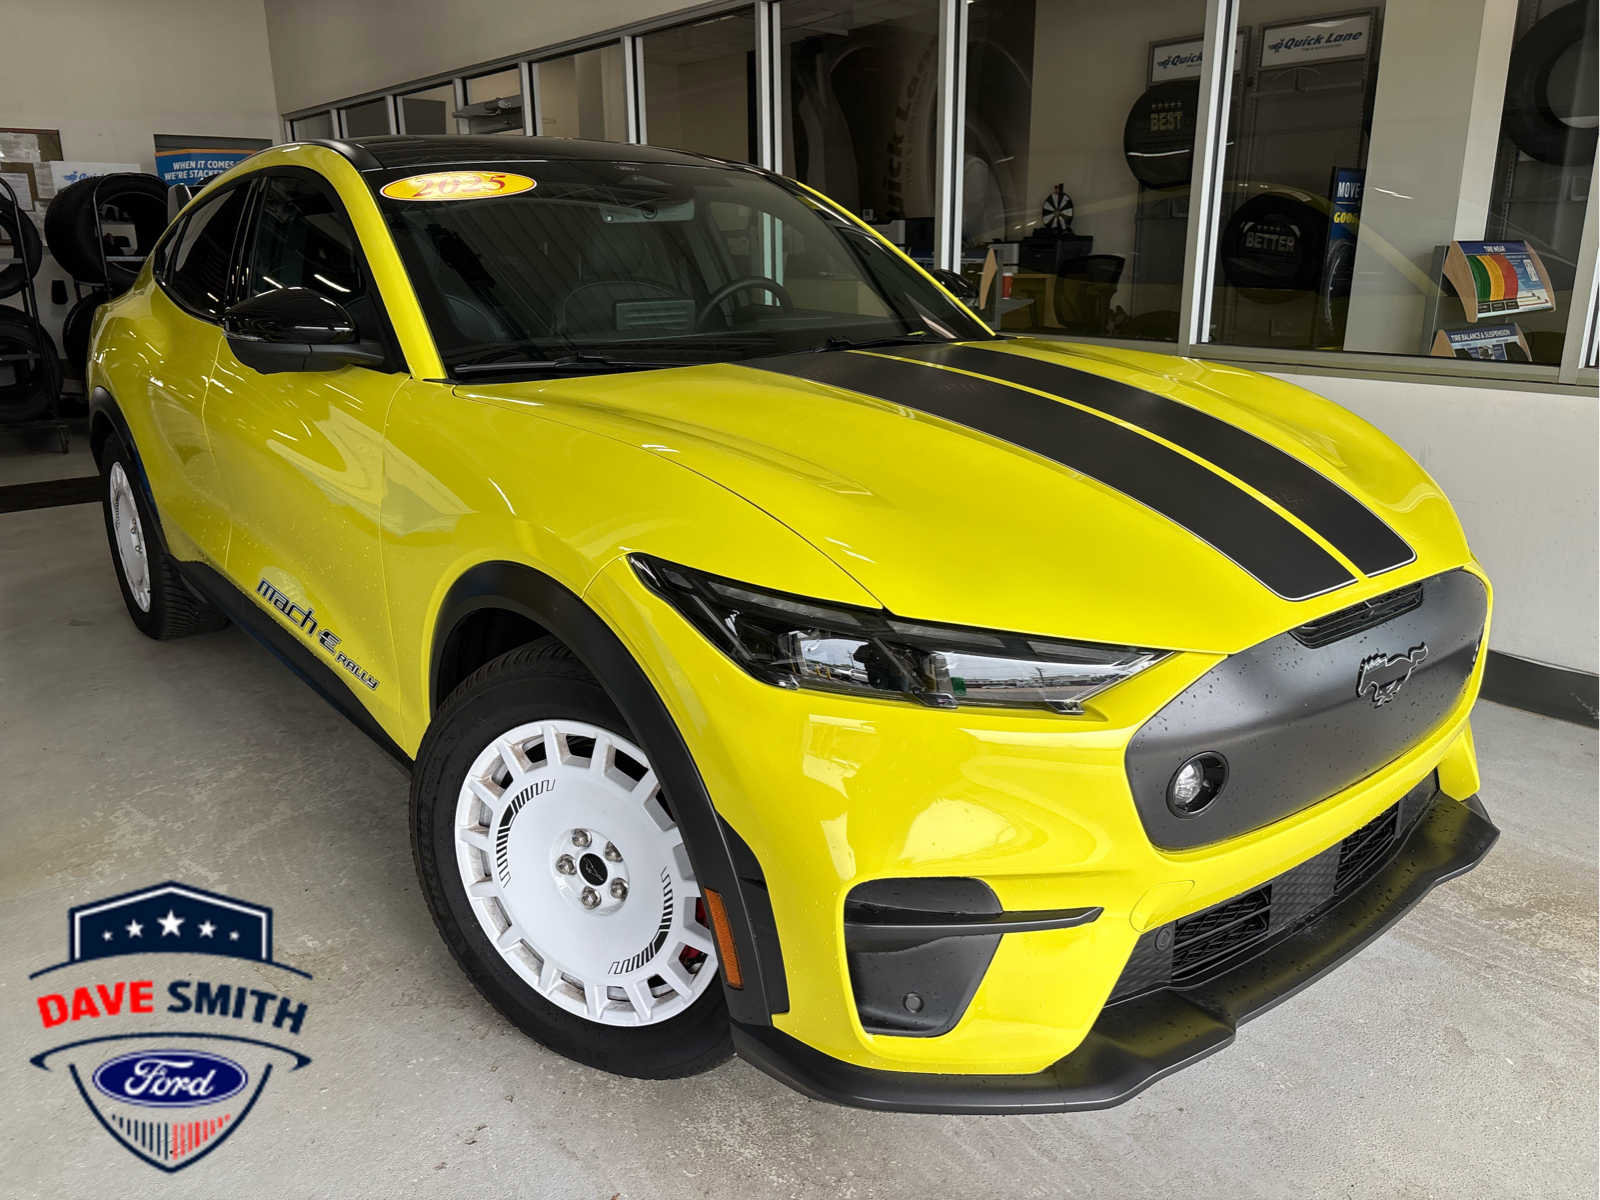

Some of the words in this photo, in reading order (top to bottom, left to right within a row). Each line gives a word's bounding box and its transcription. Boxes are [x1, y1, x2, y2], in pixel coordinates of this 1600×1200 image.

[1284, 34, 1324, 49] Quick
[1325, 32, 1362, 44] Lane
[1171, 51, 1203, 66] Quick
[1150, 111, 1184, 132] BEST
[172, 161, 196, 170] WHEN
[197, 161, 205, 169] IT
[206, 160, 235, 169] COMES
[164, 170, 187, 180] WE'RE
[412, 174, 506, 198] 2025
[1336, 182, 1361, 198] MOVE
[1245, 231, 1297, 253] BETTER
[1451, 334, 1463, 342] TIRE
[336, 651, 379, 690] RALLY
